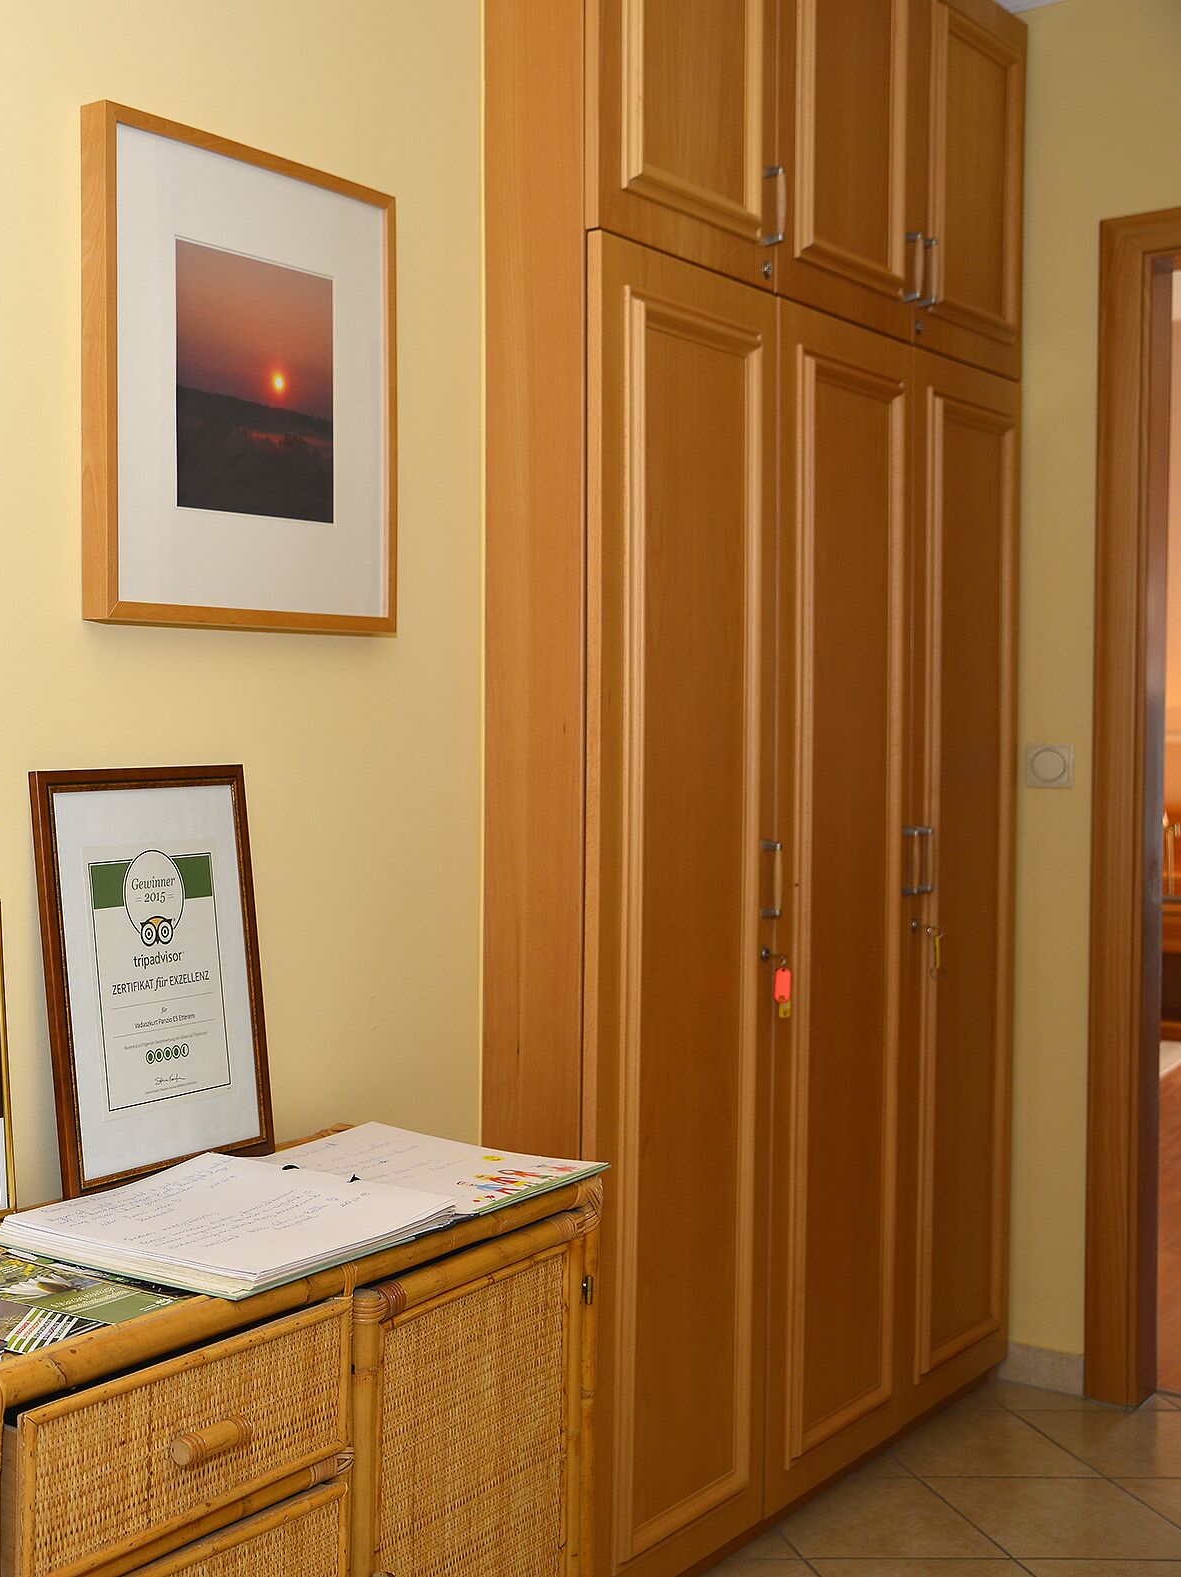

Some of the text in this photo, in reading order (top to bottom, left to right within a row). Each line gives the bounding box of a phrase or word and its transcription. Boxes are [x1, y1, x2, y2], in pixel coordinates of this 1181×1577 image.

[131, 875, 175, 891] Gewinner
[144, 892, 166, 904] 2015
[133, 951, 183, 969] tripadvisor
[112, 970, 210, 995] ZERTIFIKAT für EXZELLENZ
